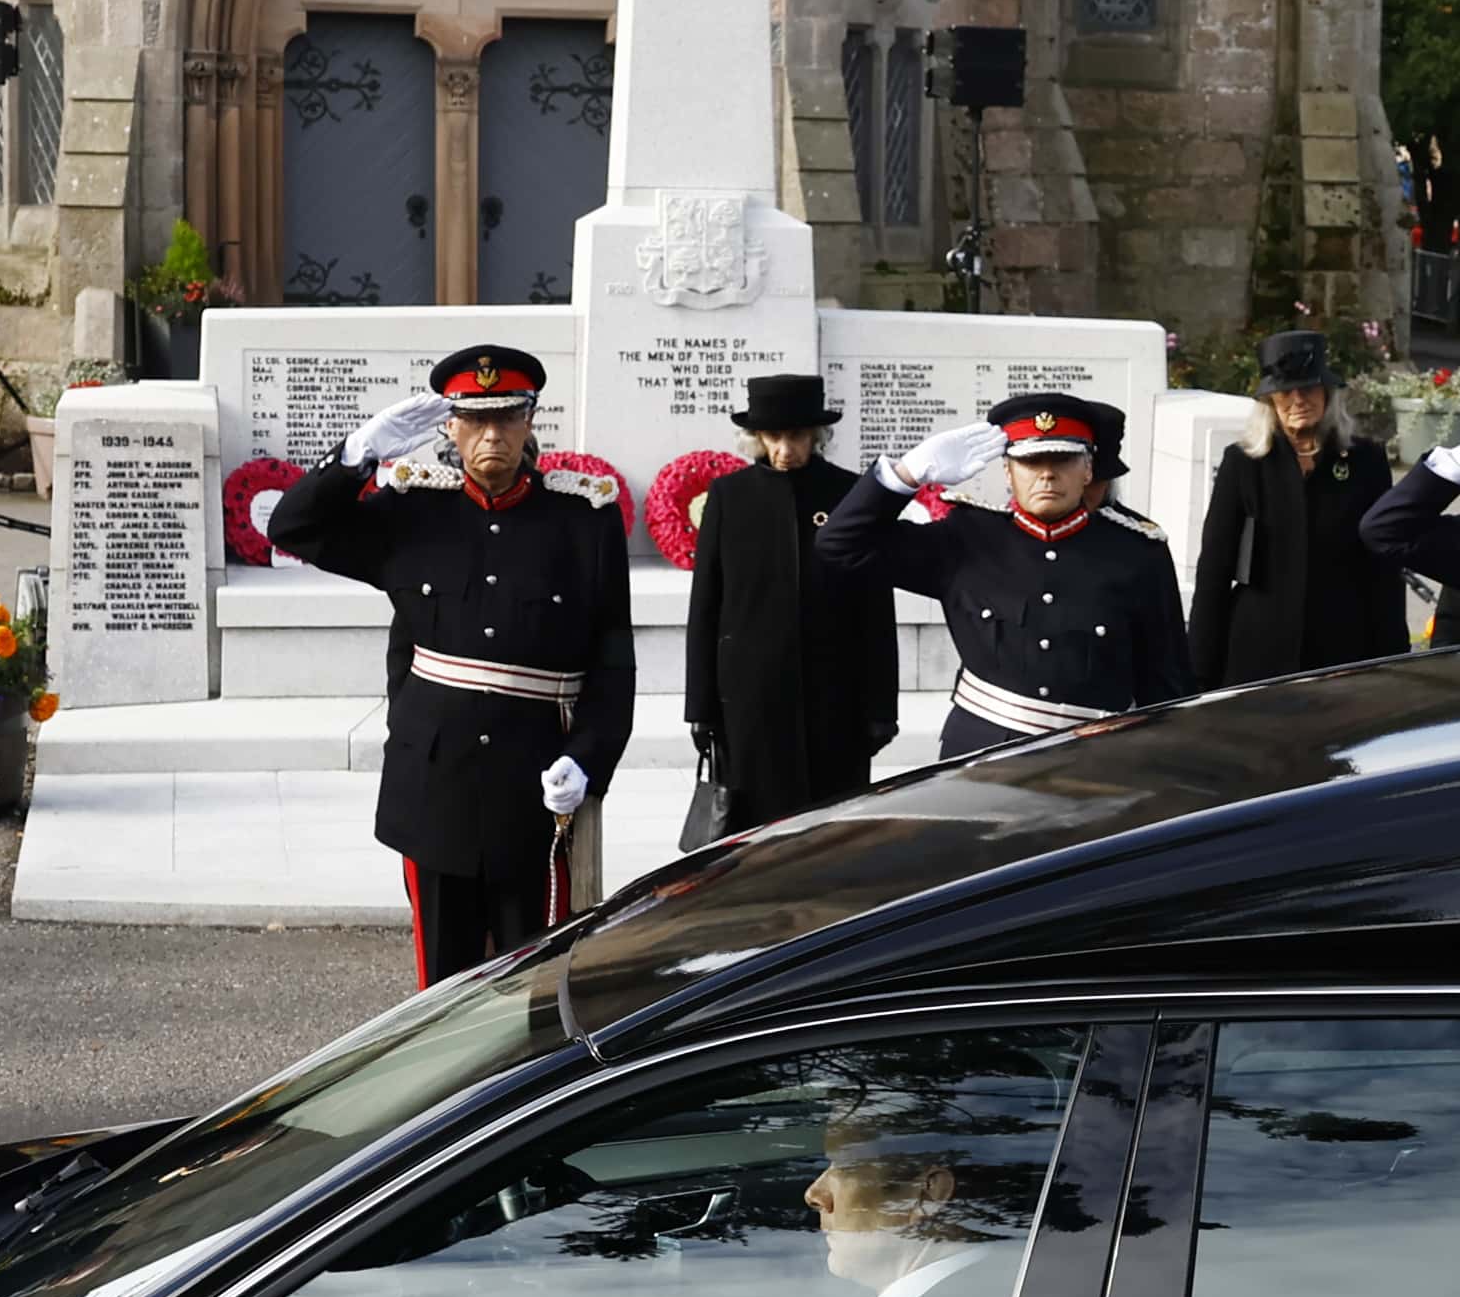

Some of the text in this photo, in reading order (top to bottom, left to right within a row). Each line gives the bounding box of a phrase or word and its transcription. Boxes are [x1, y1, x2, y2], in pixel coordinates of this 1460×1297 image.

[656, 338, 748, 348] THE NAMES OF
[619, 352, 785, 362] THE MEN OF THIS DISTRICT
[286, 358, 320, 366] GEORGE
[333, 358, 368, 366] HAYNES
[672, 365, 732, 374] WHO DIED
[287, 376, 315, 384] ALLAN
[319, 376, 344, 384] KEITH
[349, 376, 399, 384] MACKENZIE
[637, 377, 668, 387] THAT
[674, 377, 692, 387] WE
[698, 377, 735, 387] MIGHT
[287, 394, 318, 402] JAMES
[322, 394, 357, 402] HARVEY
[674, 390, 696, 400] 1914
[286, 421, 361, 429] DONALD COUTTS
[102, 436, 174, 447] 1939 1945
